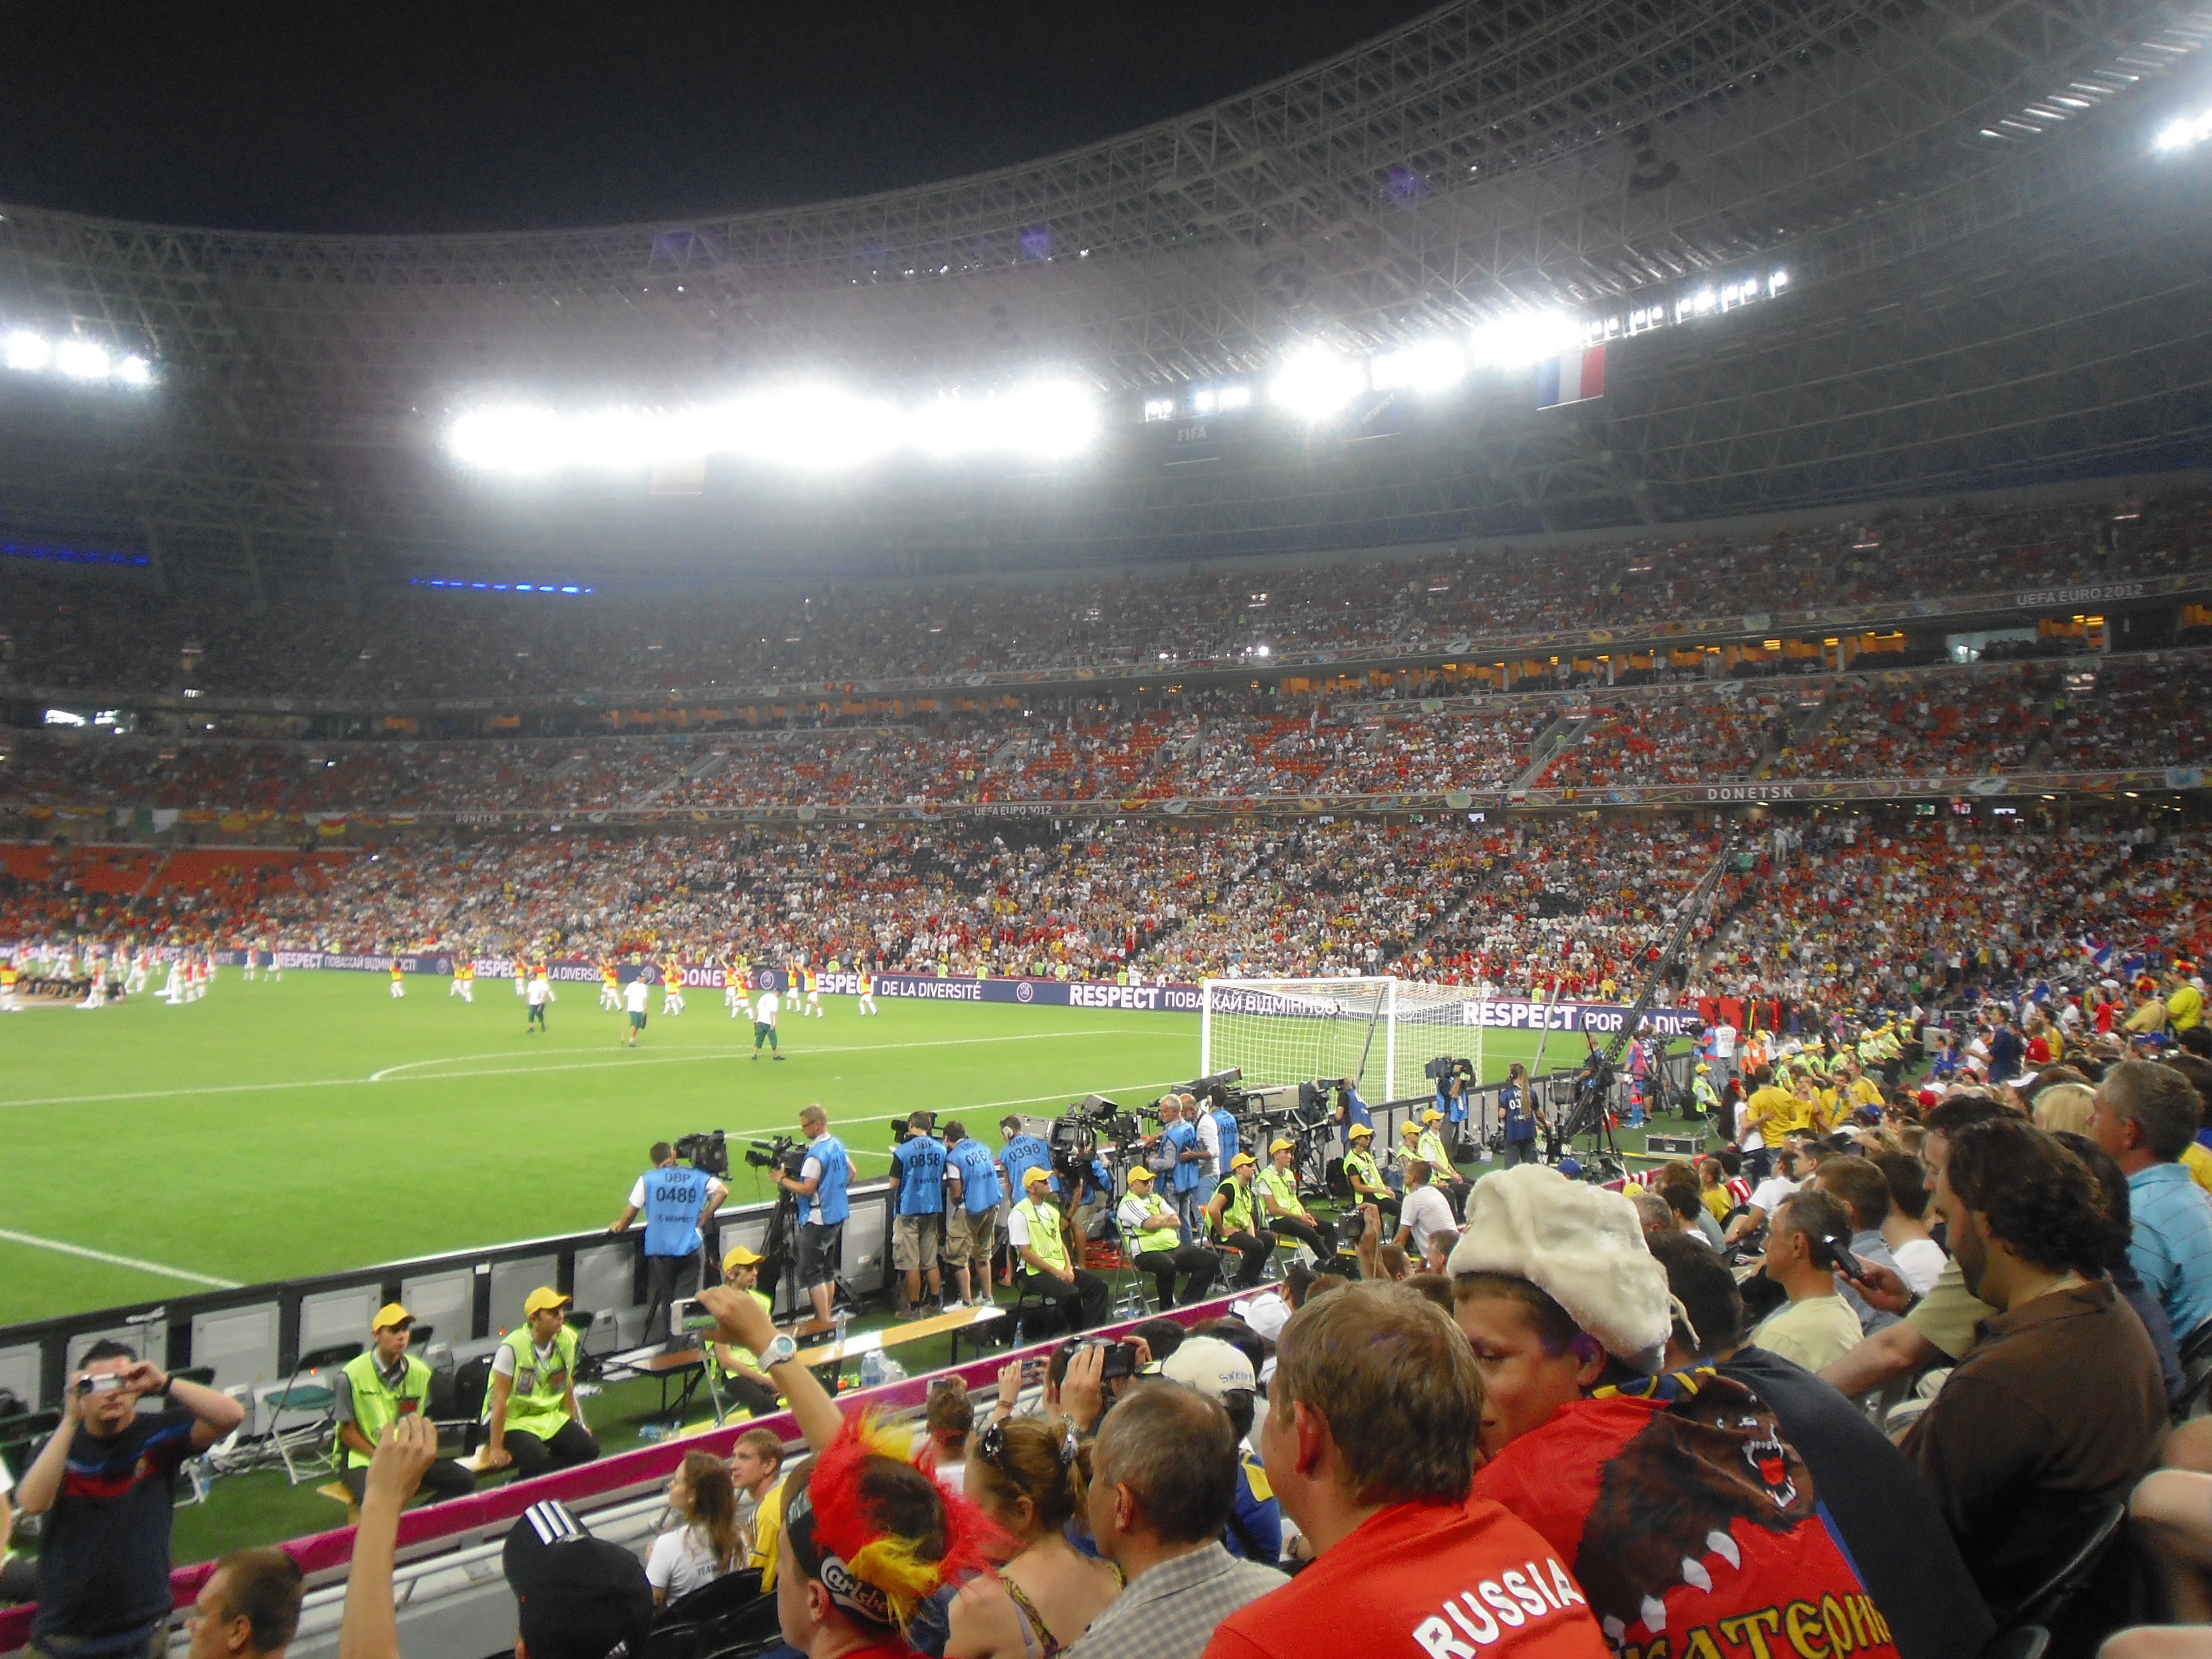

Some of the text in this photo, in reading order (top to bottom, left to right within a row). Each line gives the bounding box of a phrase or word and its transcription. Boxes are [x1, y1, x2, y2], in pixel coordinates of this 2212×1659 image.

[2017, 584, 2144, 606] UEFA EURO 2012
[1707, 786, 1795, 800] DONETSK
[975, 806, 999, 816] UEFA
[278, 952, 323, 968] RESPECT
[472, 959, 603, 982] RESPEC LA DIVERSID
[882, 981, 897, 996] DE
[900, 982, 916, 998] LA
[919, 981, 981, 1000] DIVERSITÉ
[1069, 985, 1160, 1009] RESPECT
[1463, 1001, 1578, 1030] RESPECT
[1585, 1012, 1624, 1031] POR
[909, 1152, 941, 1168] 0858
[1008, 1143, 1041, 1162] 0398
[664, 1173, 691, 1183] UBP
[656, 1187, 697, 1203] 0489
[1412, 1557, 1586, 1659] RUSSIA
